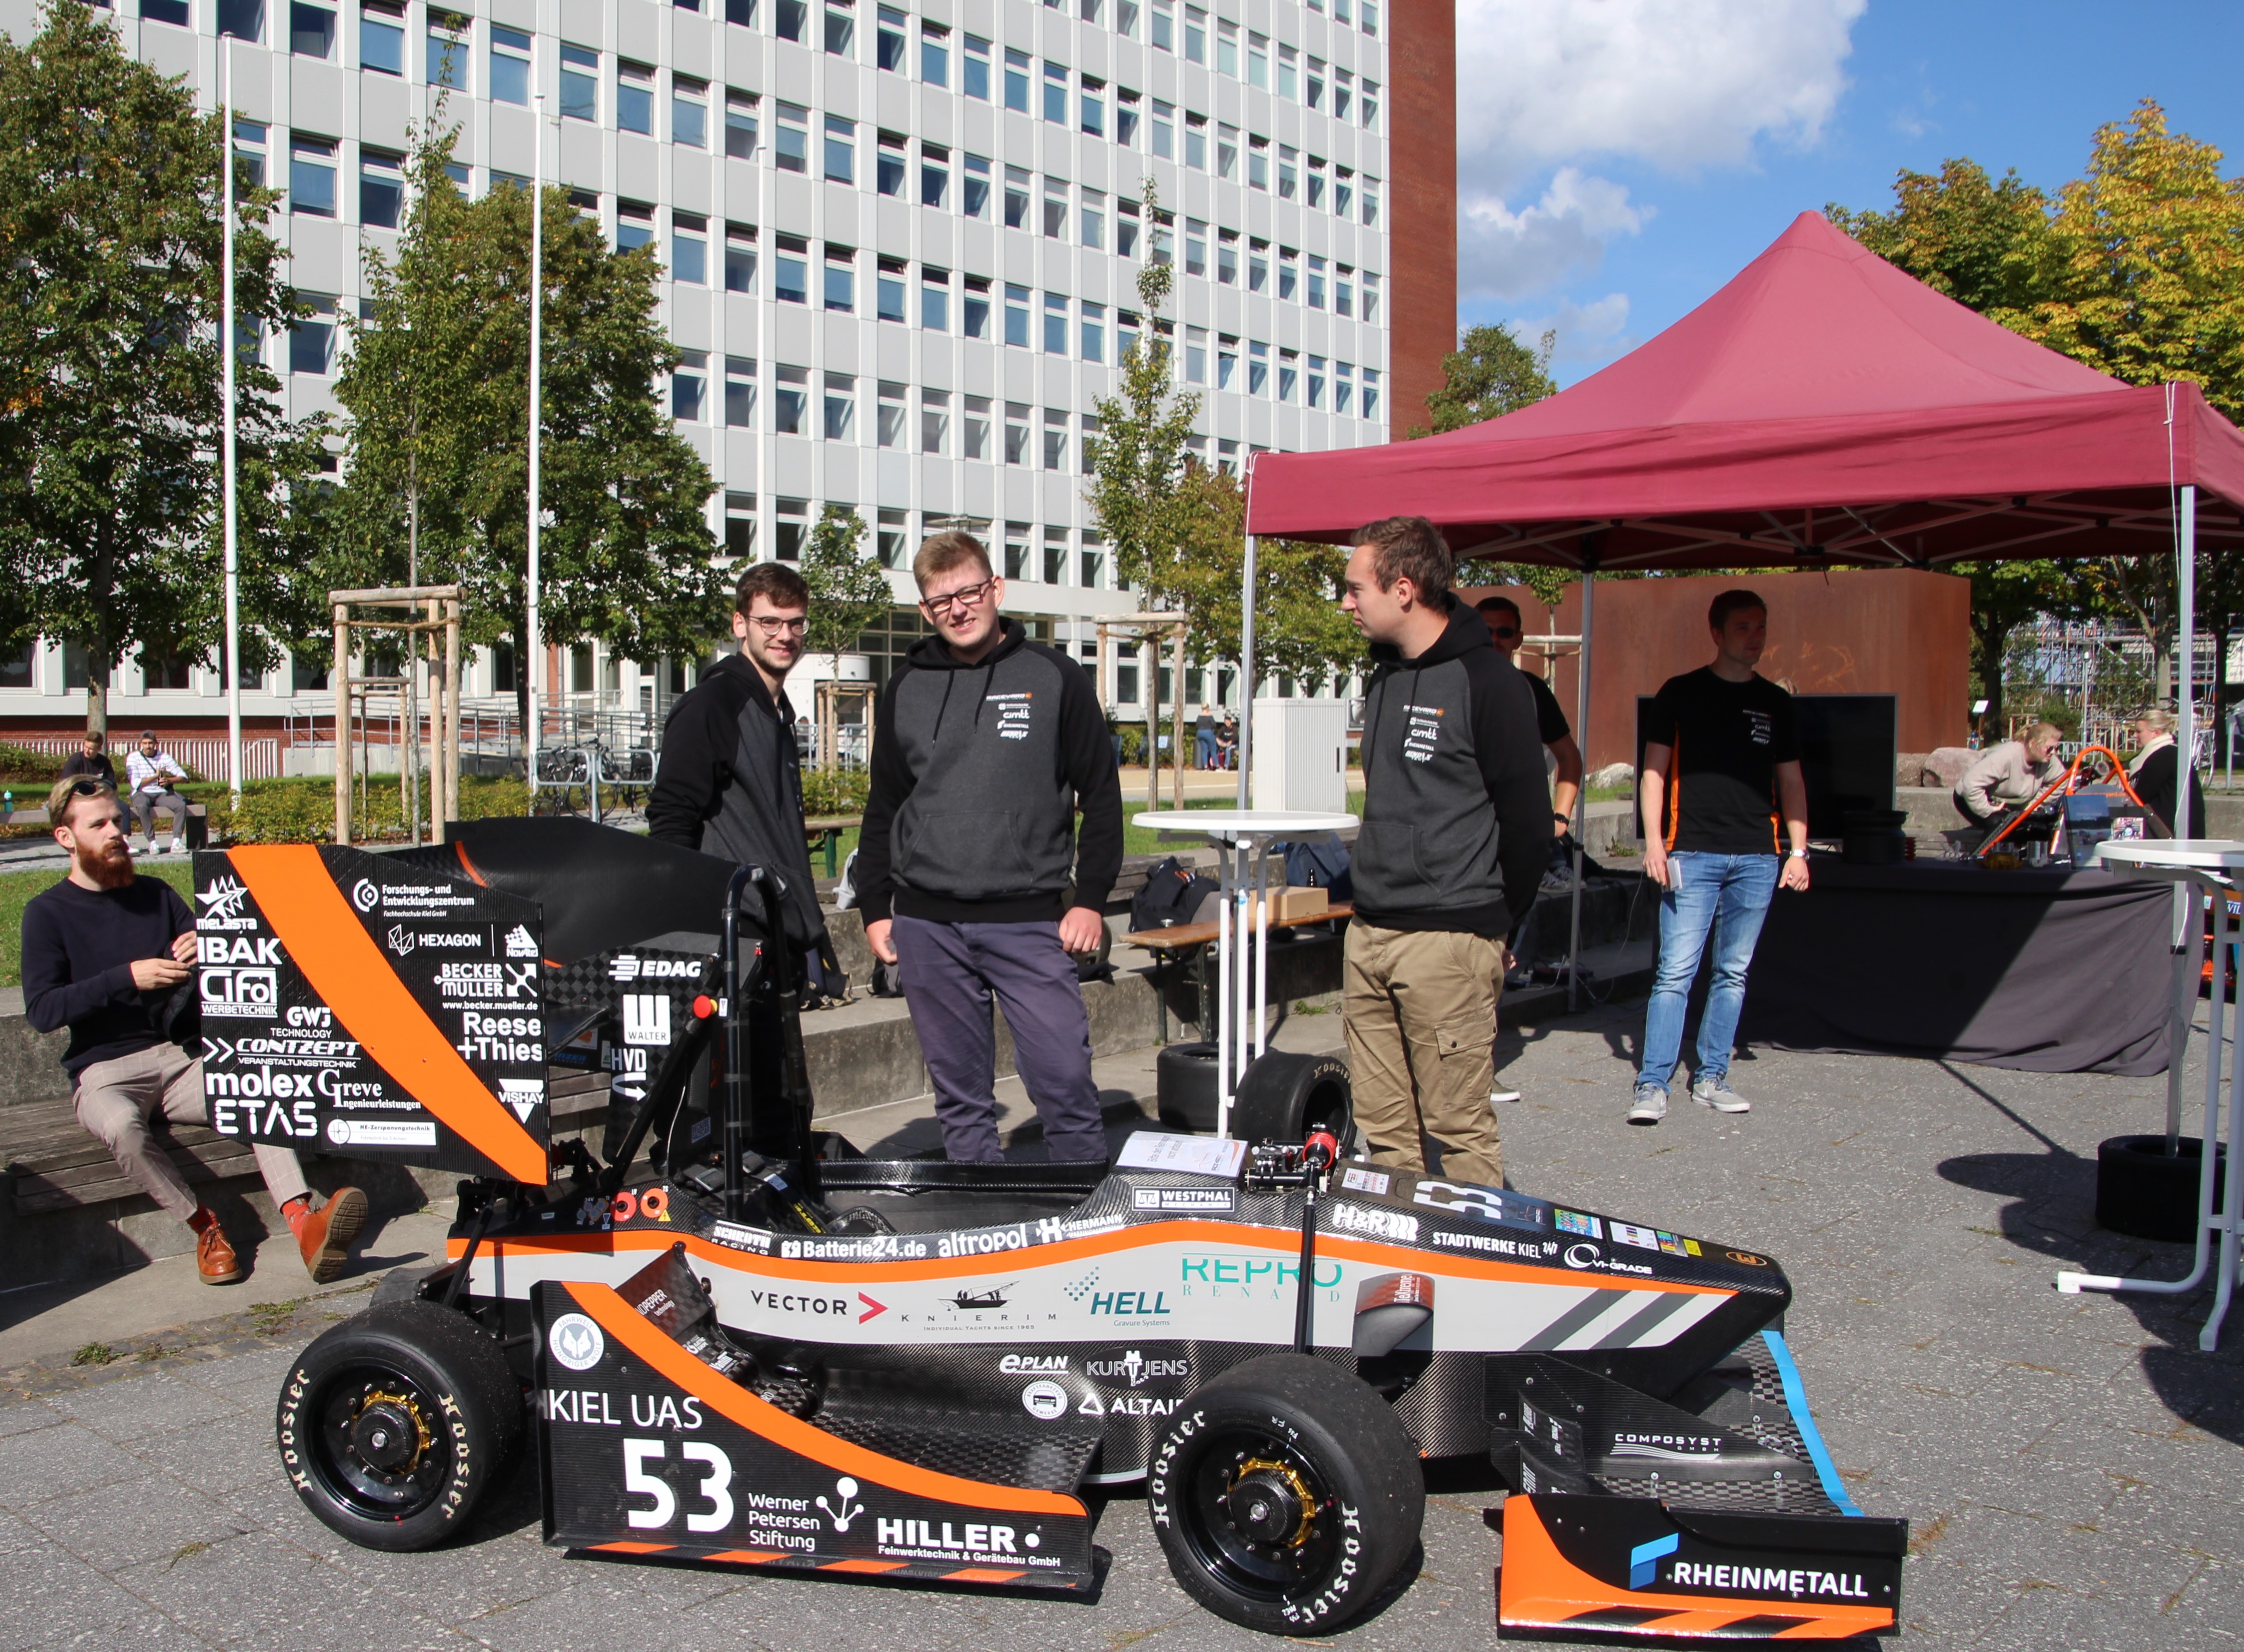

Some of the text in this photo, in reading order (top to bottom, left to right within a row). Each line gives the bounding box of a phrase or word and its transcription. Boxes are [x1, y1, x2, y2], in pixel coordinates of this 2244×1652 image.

[382, 885, 451, 896] Forschungs- und
[382, 896, 474, 907] Entwicklungszentrum
[197, 937, 282, 965] IBAK
[419, 934, 481, 947] HEXAGON
[441, 963, 502, 979] BECKER
[641, 961, 701, 977] EDAG
[202, 1005, 277, 1016] WERBETECHNIK
[287, 1006, 331, 1027] GWJ
[443, 1001, 538, 1011] www.becker.mueller.de
[271, 1028, 332, 1039] TECHNOLOGY
[463, 1012, 541, 1037] Reese
[628, 1032, 666, 1041] WALTER
[457, 1037, 542, 1061] +Thies
[238, 1057, 356, 1068] VERANSTALTUNGSTECHNIK
[611, 1048, 647, 1072] HVD
[206, 1066, 314, 1097] molex
[498, 1091, 544, 1103] VISHAY
[216, 1099, 317, 1137] ETAS
[1162, 1191, 1230, 1201] WESTPHAL
[1069, 1214, 1123, 1231] HERMANN
[1333, 1203, 1389, 1235] H&R
[711, 1238, 768, 1255] RACING
[803, 1238, 926, 1259] Batterie24.de
[939, 1224, 1027, 1258] altropol
[1433, 1232, 1516, 1255] STADTWERKE
[1519, 1243, 1541, 1259] KIEL
[1182, 1258, 1342, 1287] REPRO
[1592, 1259, 1652, 1274] VI-GRADE
[751, 1289, 846, 1315] VECTOR
[1090, 1291, 1170, 1314] HELL
[1182, 1284, 1340, 1302] RENAD
[654, 1300, 675, 1316] technology
[558, 1316, 593, 1328] FAHRWELT
[553, 1339, 601, 1367] HUNGRIGER WOLF
[1000, 1354, 1068, 1374] ePLAN
[1141, 1360, 1187, 1376] JENS
[549, 1389, 703, 1429] KIEL UAS
[1111, 1398, 1184, 1415] ALTAI
[281, 1369, 314, 1492] Hoosier
[1615, 1433, 1721, 1445] COMPOSYST
[438, 1393, 471, 1518] Hoosier
[1152, 1410, 1205, 1529] Hoosier
[623, 1438, 734, 1533] 53
[749, 1493, 809, 1512] Werner
[749, 1511, 821, 1531] Petersen
[750, 1530, 816, 1552] Stiftung
[878, 1518, 1016, 1552] HILLER
[878, 1545, 1060, 1566] Feinwerktechnik & Gerätebau GmbH
[1302, 1501, 1361, 1623] Hoosier
[1674, 1561, 1868, 1597] RHEINMETALL
